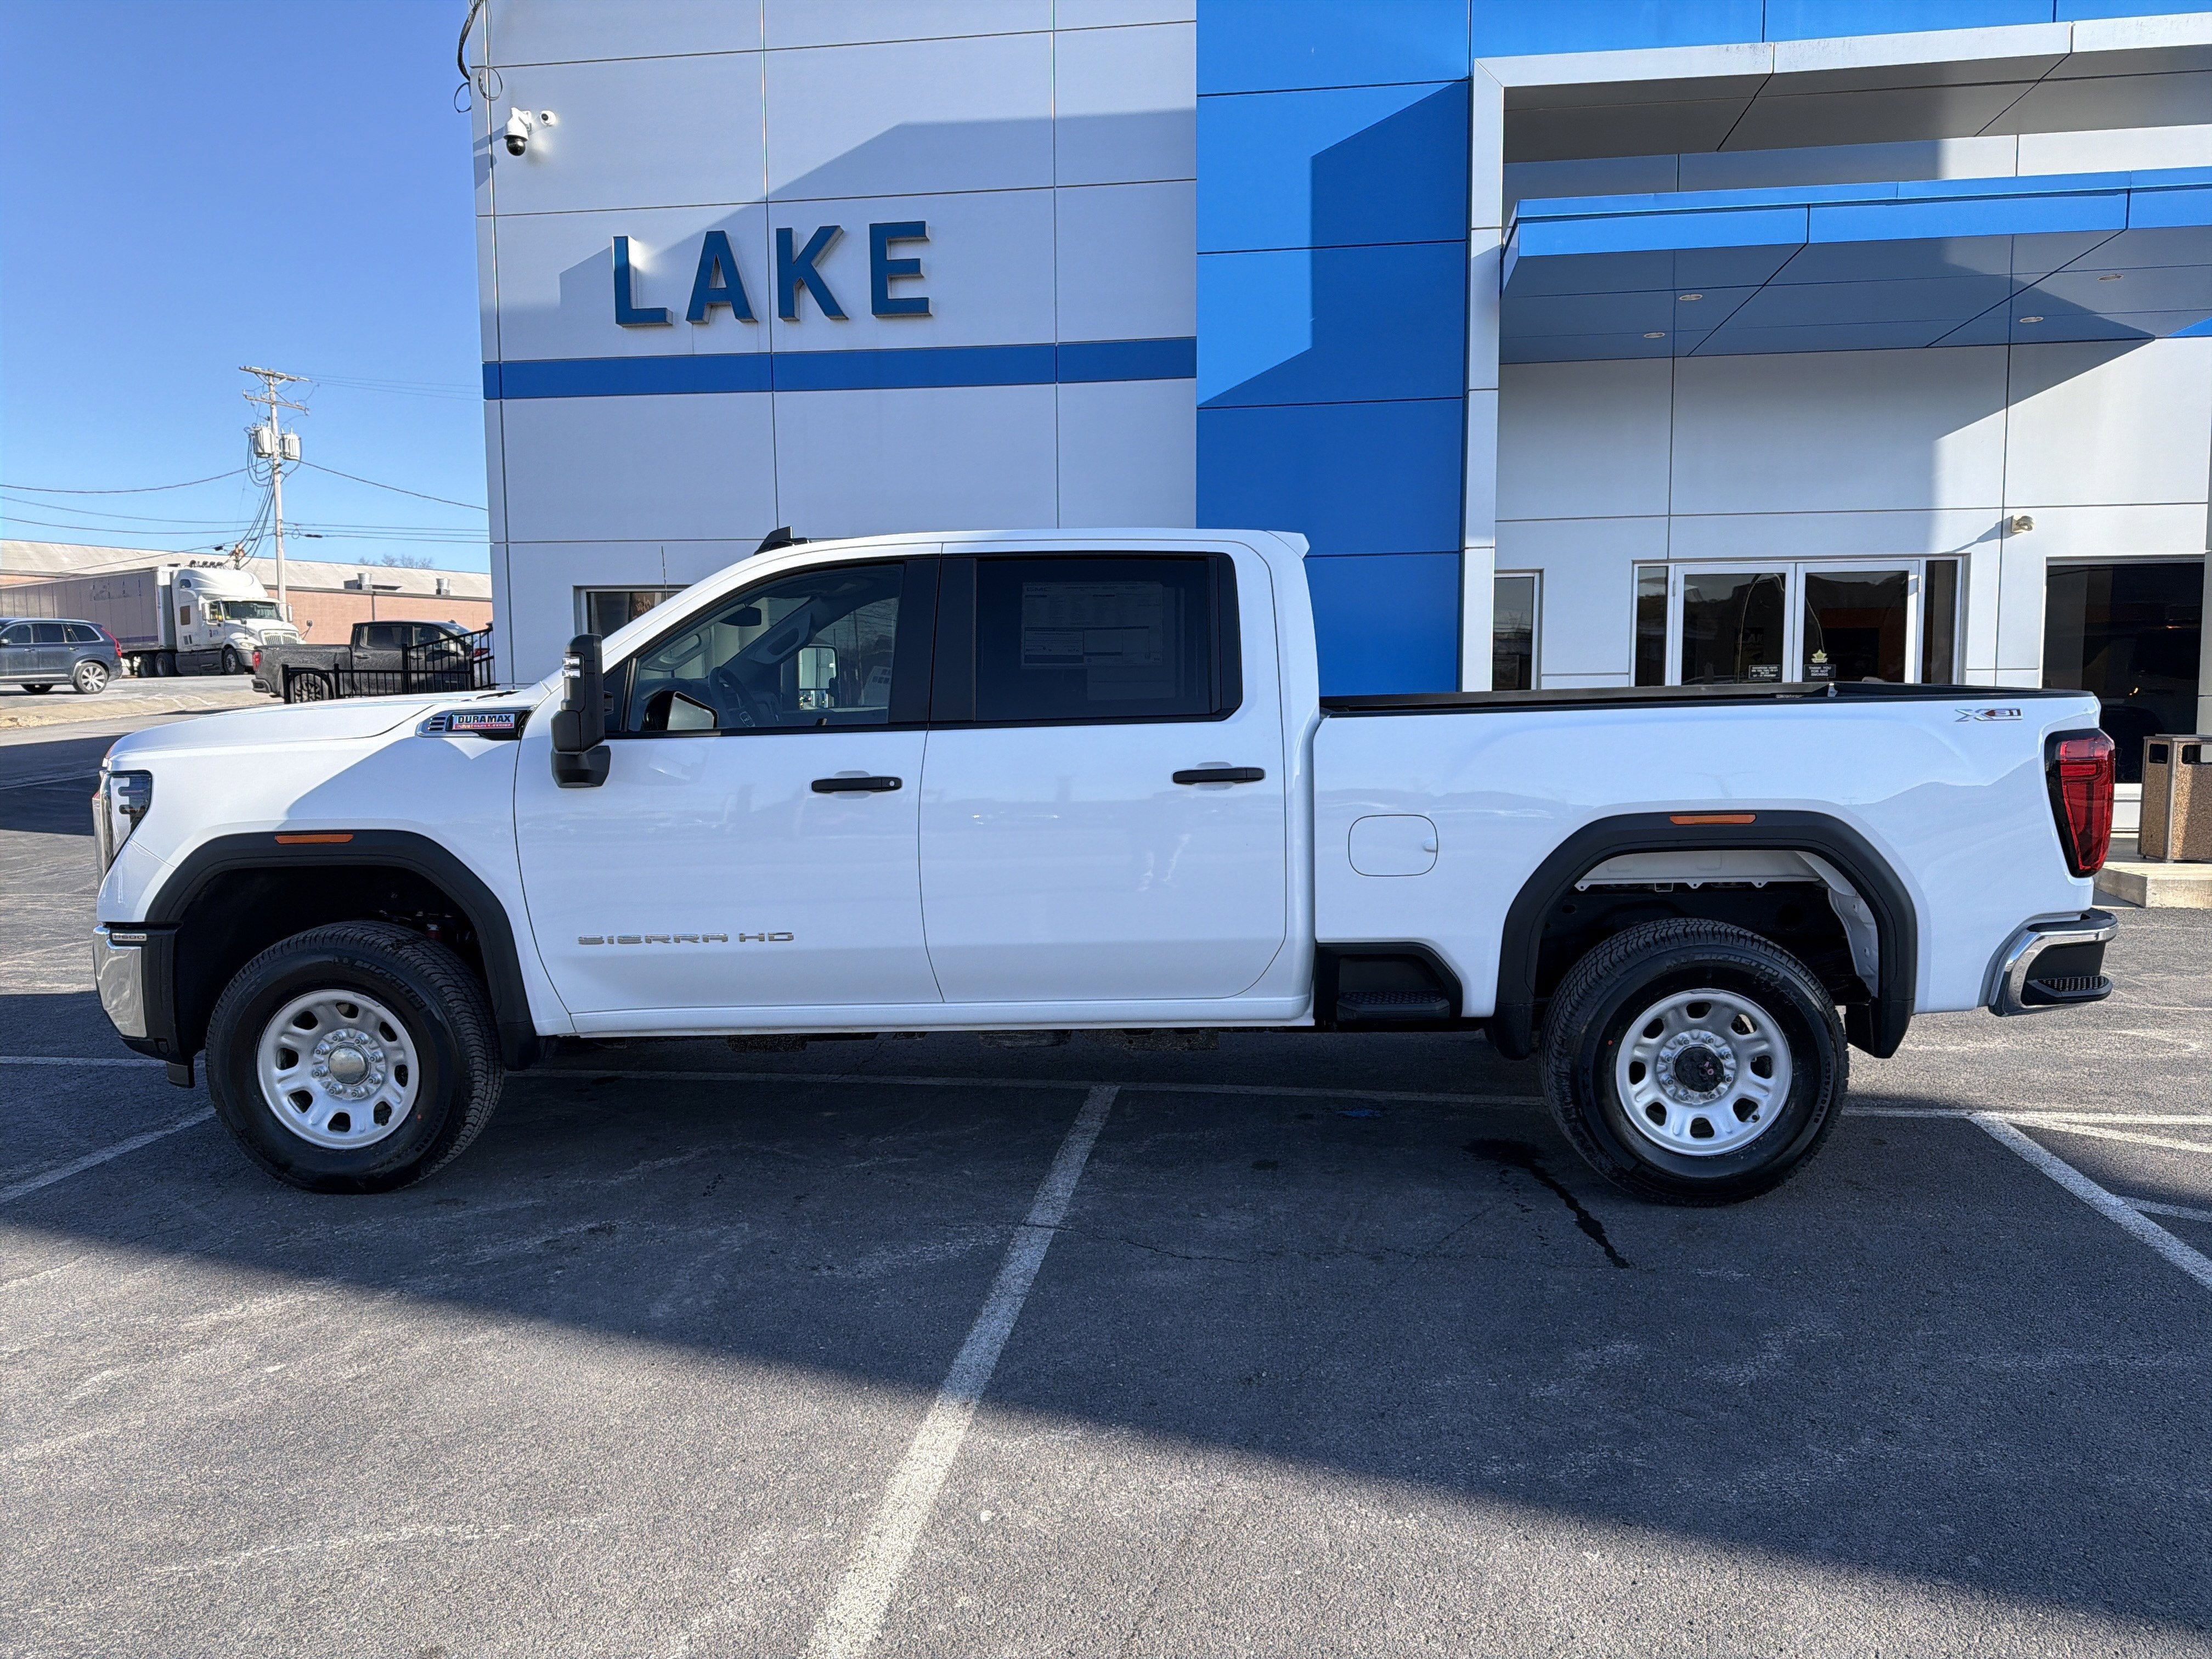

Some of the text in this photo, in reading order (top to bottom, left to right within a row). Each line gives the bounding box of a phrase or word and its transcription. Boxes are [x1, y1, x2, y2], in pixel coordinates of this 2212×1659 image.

[612, 221, 933, 326] LAKE
[458, 714, 511, 724] DURAMAX
[578, 932, 794, 945] SIERRA HD
